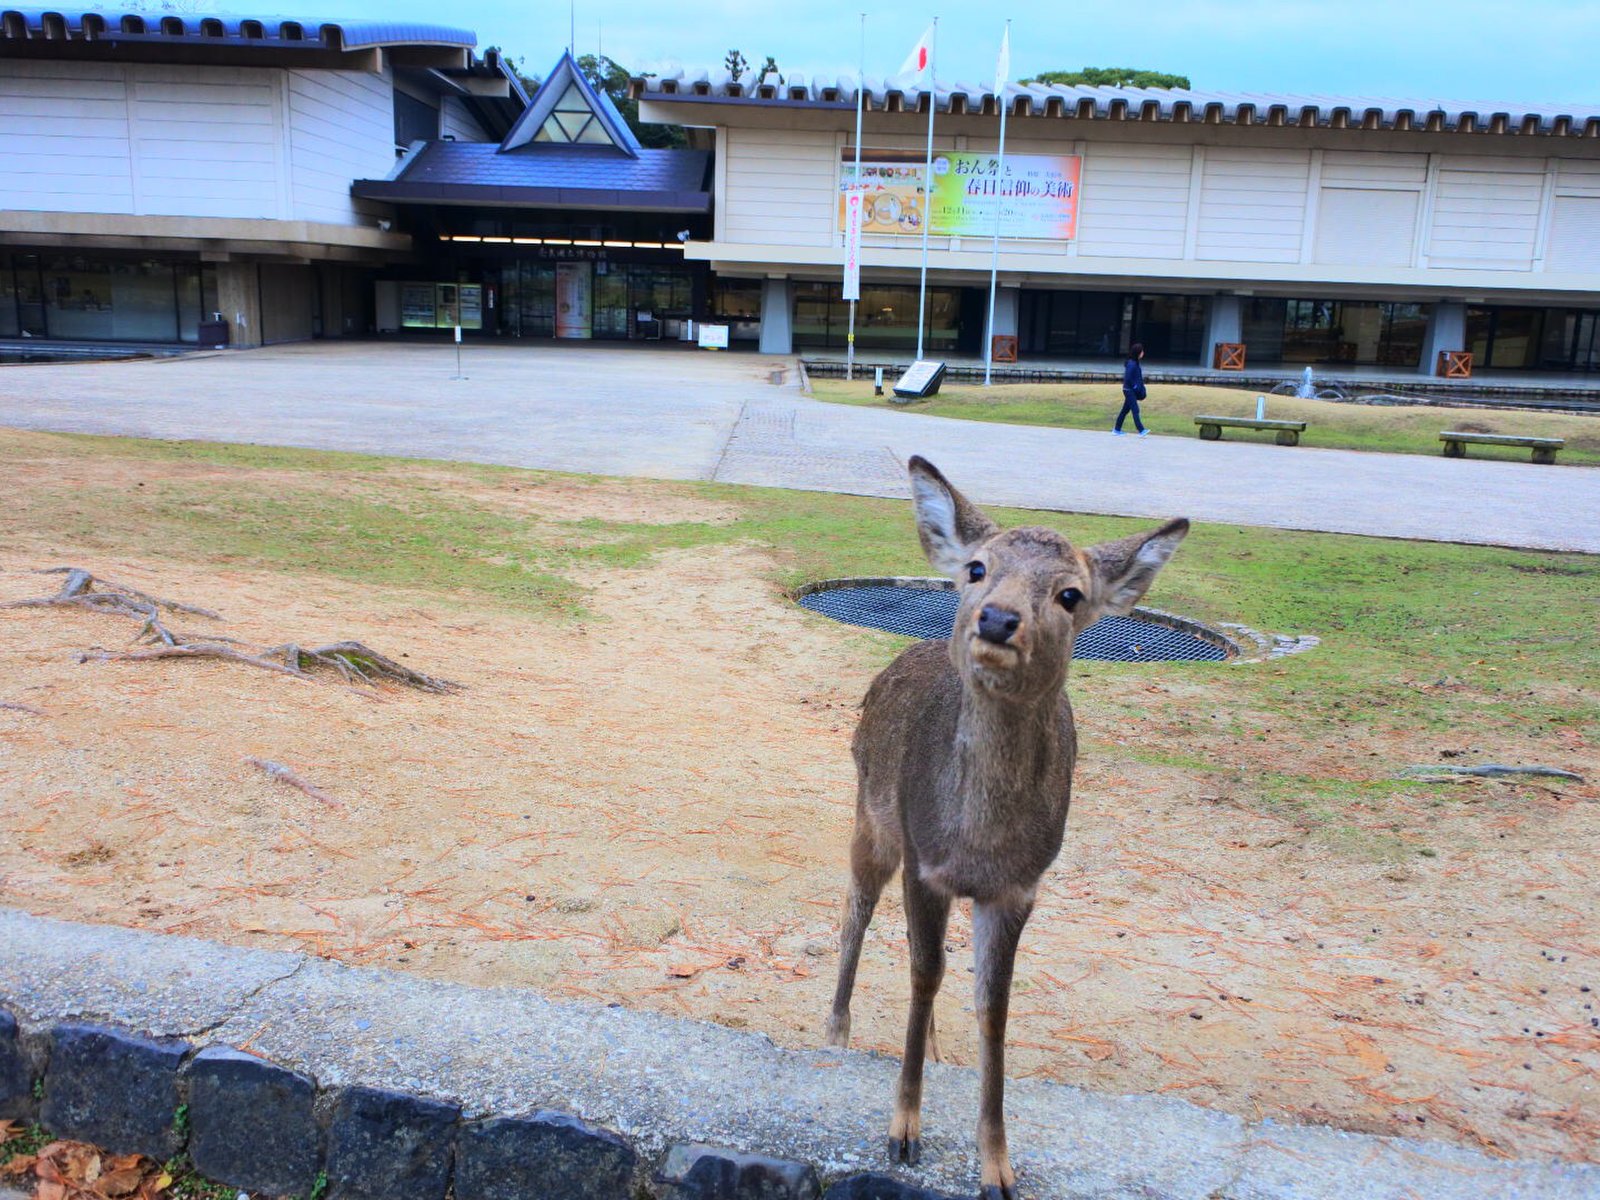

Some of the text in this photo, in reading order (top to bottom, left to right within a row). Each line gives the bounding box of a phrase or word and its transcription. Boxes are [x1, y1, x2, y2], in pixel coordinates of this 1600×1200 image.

[955, 159, 1012, 177] おん祭と
[968, 178, 1073, 198] 春日信仰の美術
